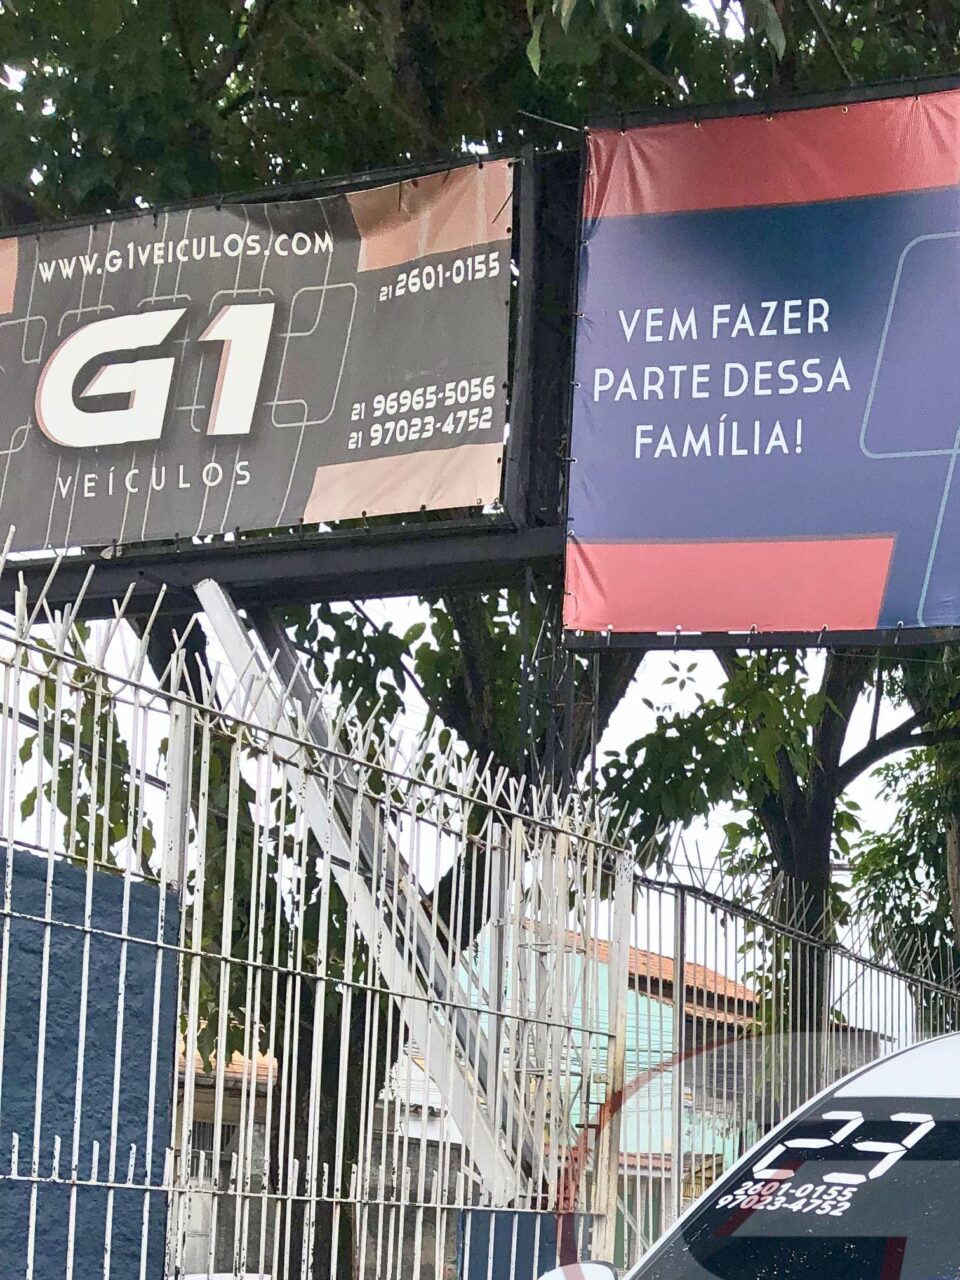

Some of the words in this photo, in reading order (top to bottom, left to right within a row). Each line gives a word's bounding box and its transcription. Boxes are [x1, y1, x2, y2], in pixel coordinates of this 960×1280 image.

[38, 231, 334, 284] WWW.G1VEICULOS.COM
[379, 284, 393, 301] 21
[395, 252, 500, 298] 2601-0155
[618, 304, 698, 343] VEM
[712, 297, 830, 339] FAZER
[34, 302, 276, 448] G1
[593, 362, 710, 402] PARTE
[724, 356, 851, 397] DESSA
[351, 403, 365, 422] 21
[372, 375, 496, 418] 96965-5056
[348, 431, 362, 450] 21
[370, 408, 493, 448] 97023-4752
[633, 413, 803, 459] FAMÍLIA!
[57, 460, 251, 499] VEÍCULOS
[752, 1110, 936, 1186] 23
[715, 1194, 851, 1217] 97023-4752
[732, 1181, 859, 1201] 2601-0155
